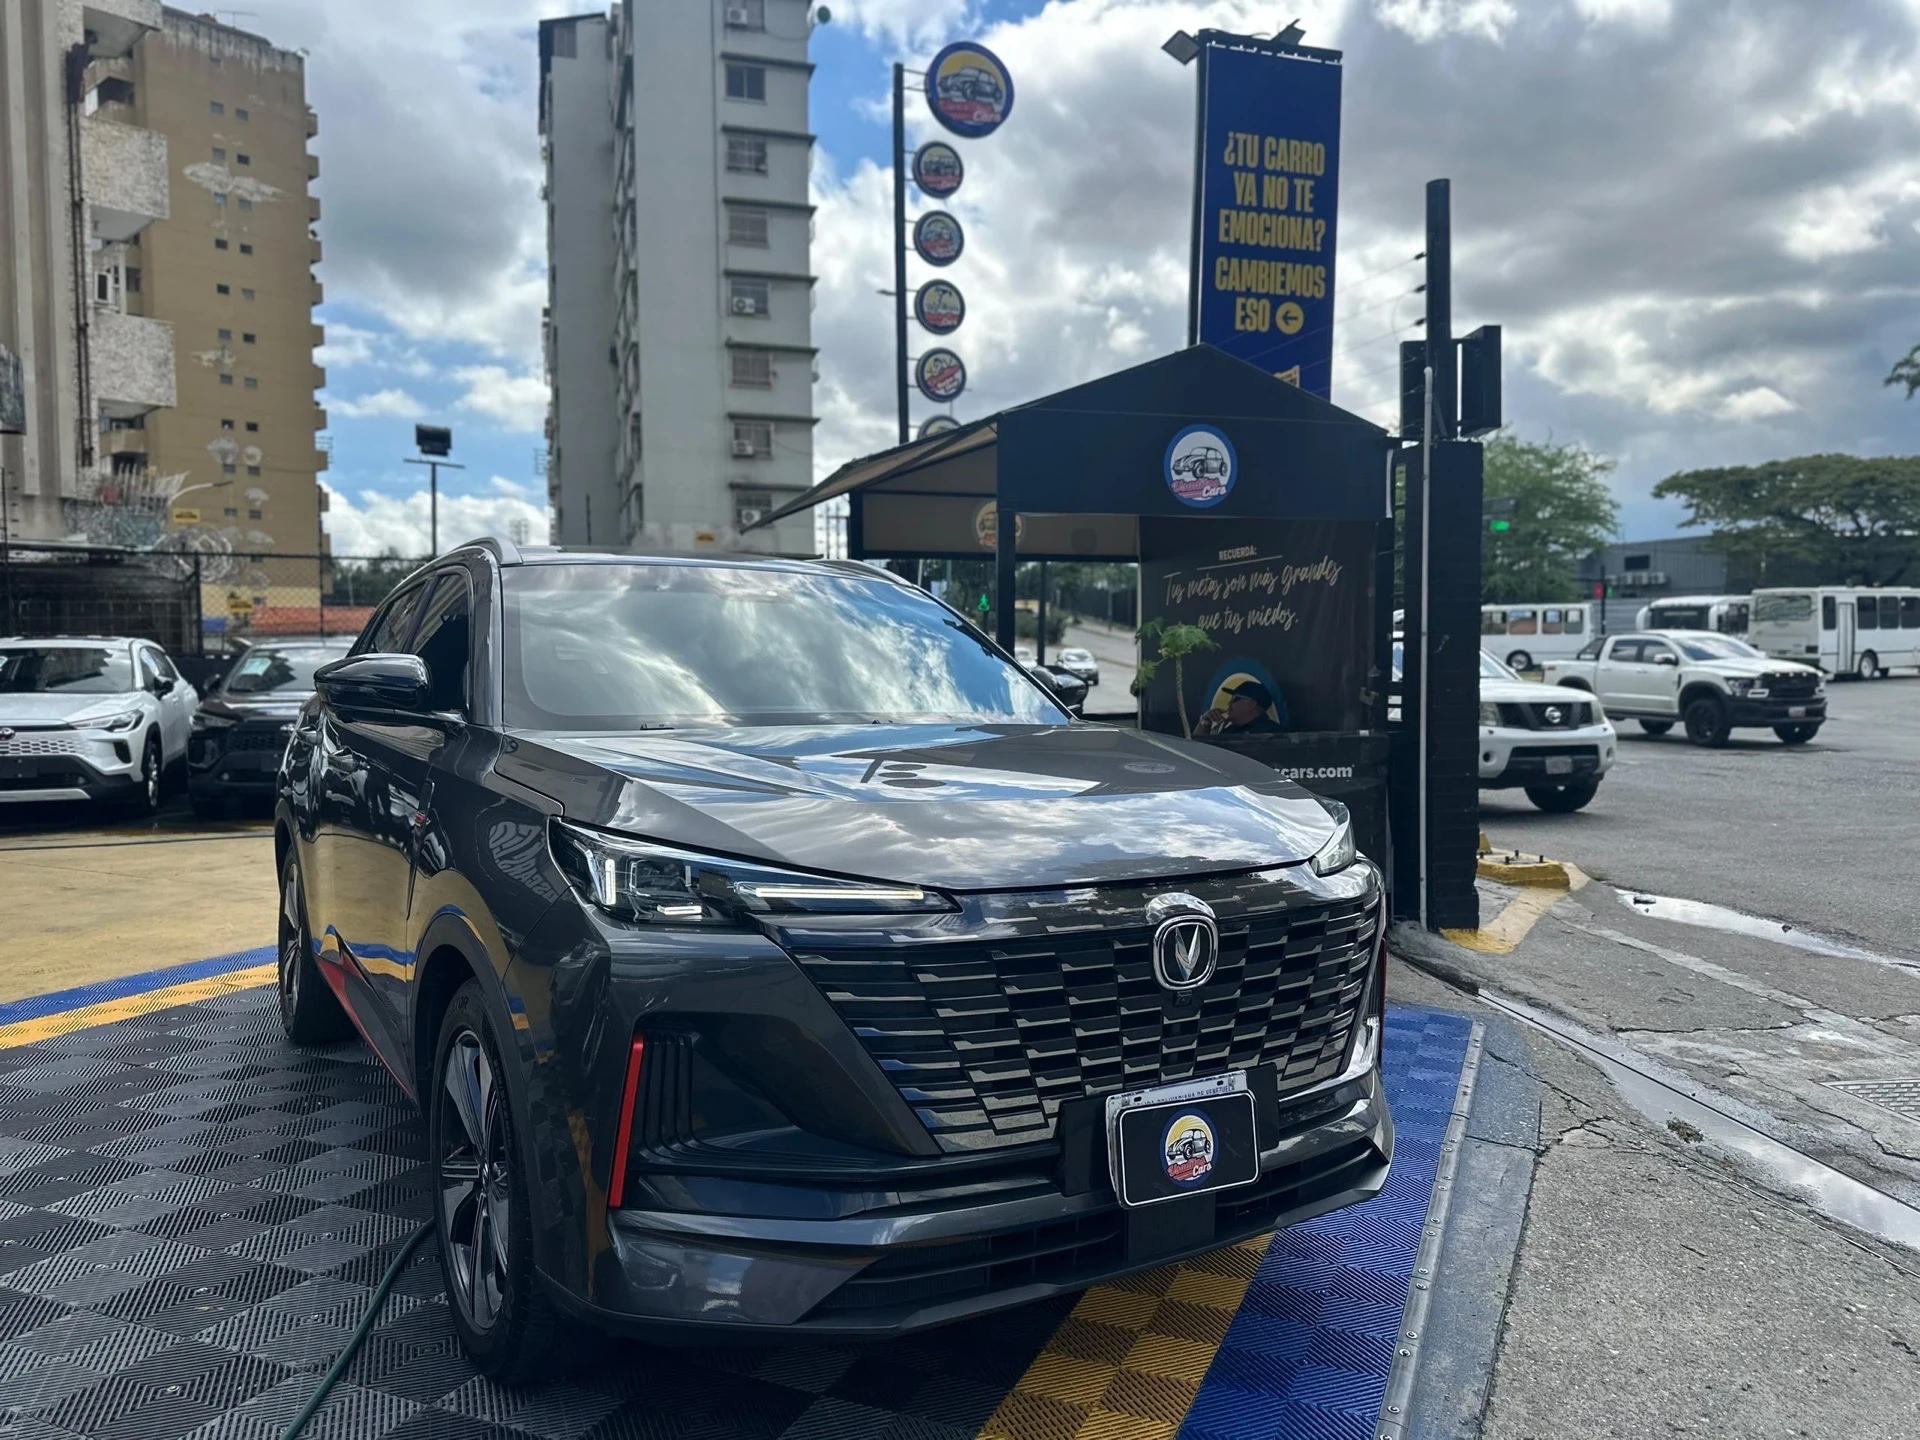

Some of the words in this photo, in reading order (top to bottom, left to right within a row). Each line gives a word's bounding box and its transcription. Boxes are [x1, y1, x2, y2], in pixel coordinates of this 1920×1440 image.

[1223, 131, 1259, 168] ¿TU
[1264, 135, 1325, 177] CARRO
[1233, 171, 1257, 207] YA
[1262, 174, 1288, 211] NO
[1294, 177, 1315, 213] TE
[1218, 208, 1326, 252] EMOCIONA?
[1215, 256, 1326, 299] CAMBIEMOS
[1235, 298, 1270, 332] ESO
[1202, 485, 1227, 498] Cars
[1218, 545, 1258, 562] RECUERDA:
[1163, 571, 1185, 605] Tus
[1187, 572, 1223, 600] metas
[1222, 573, 1247, 599] son
[1249, 566, 1279, 595] más
[1281, 555, 1343, 596] grandes
[1197, 612, 1222, 630] que
[1224, 606, 1245, 634] tus
[1247, 601, 1299, 631] miedos.
[1192, 1162, 1213, 1177] Cars
